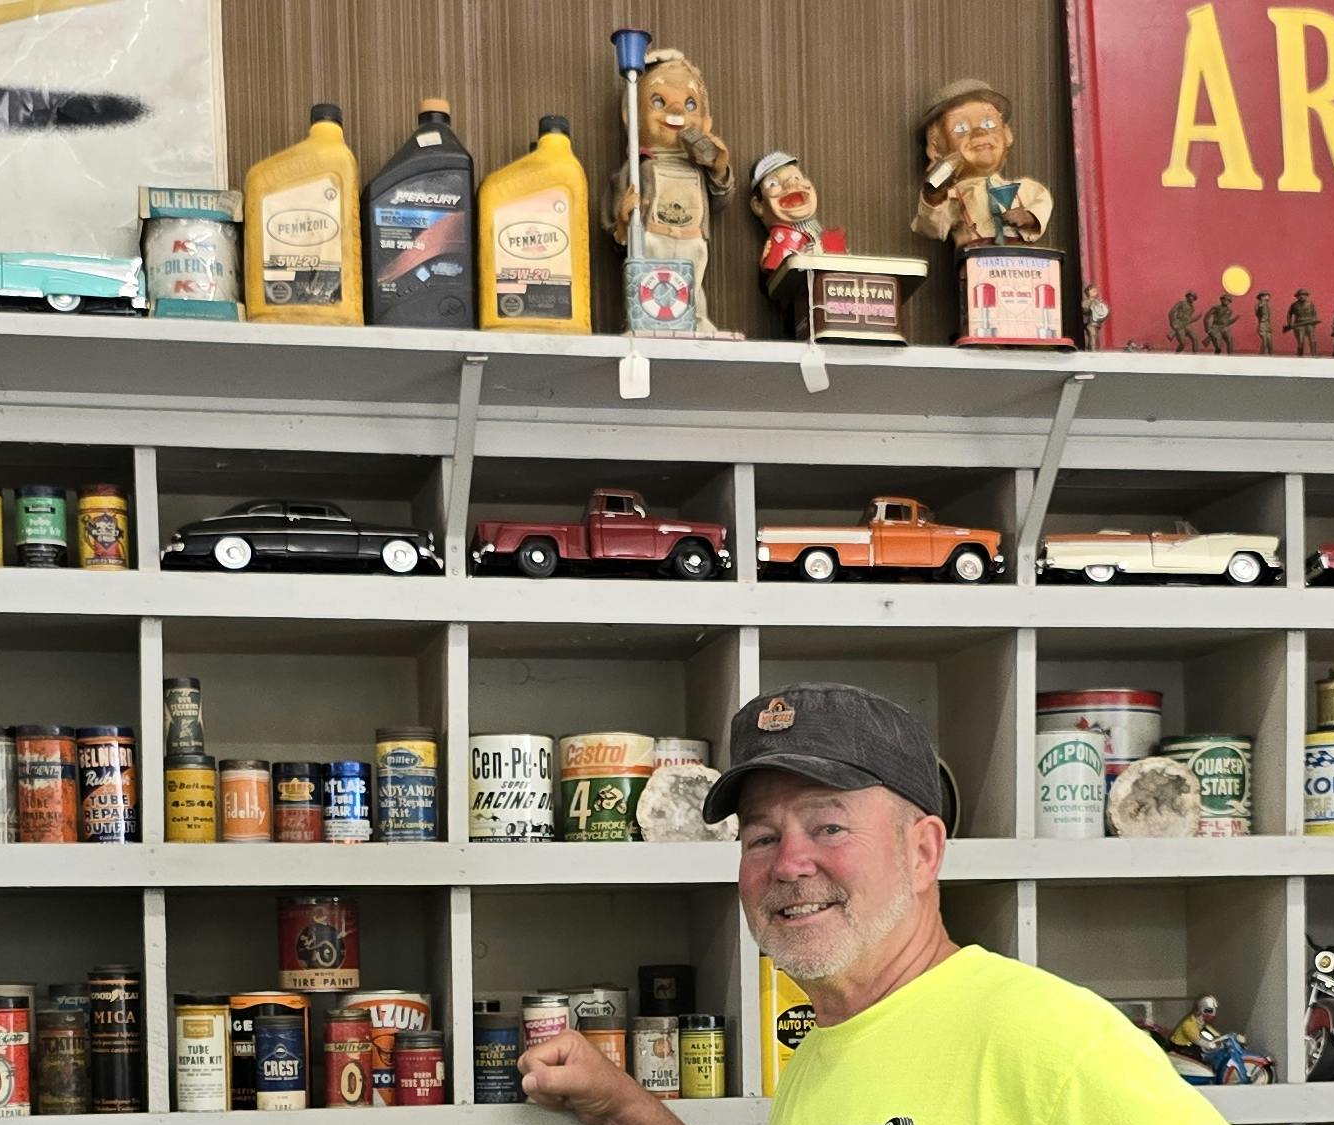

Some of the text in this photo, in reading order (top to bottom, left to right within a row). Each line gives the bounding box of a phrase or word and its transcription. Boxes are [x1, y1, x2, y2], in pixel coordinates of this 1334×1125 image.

[151, 192, 218, 210] OIL FILTER
[396, 190, 460, 204] MERCURY
[277, 220, 329, 235] PENNZOIL
[509, 232, 559, 248] PENNZOIL
[277, 255, 319, 268] 5W-20
[165, 261, 185, 276] OIL
[989, 269, 1041, 279] BARTENDER
[509, 269, 550, 281] 5W-20
[827, 286, 893, 299] CRAGSTAN
[567, 743, 627, 766] Castrol
[1195, 758, 1243, 775] QUAKER
[325, 780, 366, 793] ATLAS
[501, 781, 530, 789] SUPER
[1202, 779, 1241, 795] STATE
[1041, 784, 1102, 801] 2 CYCLE
[89, 795, 128, 805] TUBE
[399, 798, 433, 808] Repair
[472, 792, 534, 810] RACING
[569, 781, 591, 829] 4
[225, 790, 267, 825] Fidelity
[389, 808, 410, 817] Kit
[84, 810, 136, 819] REPAIR
[590, 821, 626, 831] STROKE
[609, 831, 624, 839] OIL
[293, 977, 353, 987] TIRE PAINT
[95, 1011, 136, 1024] MICA
[371, 1004, 426, 1031] LZUM
[580, 1007, 612, 1016] PHILLIPS
[778, 1020, 801, 1030] AUTO
[187, 1045, 209, 1055] TUBE
[179, 1055, 222, 1066] REPAIR KIT
[684, 1056, 701, 1065] TUBE
[264, 1060, 299, 1077] CREST
[651, 1070, 673, 1079] TUBE
[698, 1065, 713, 1073] KIT
[417, 1088, 430, 1097] KIT
